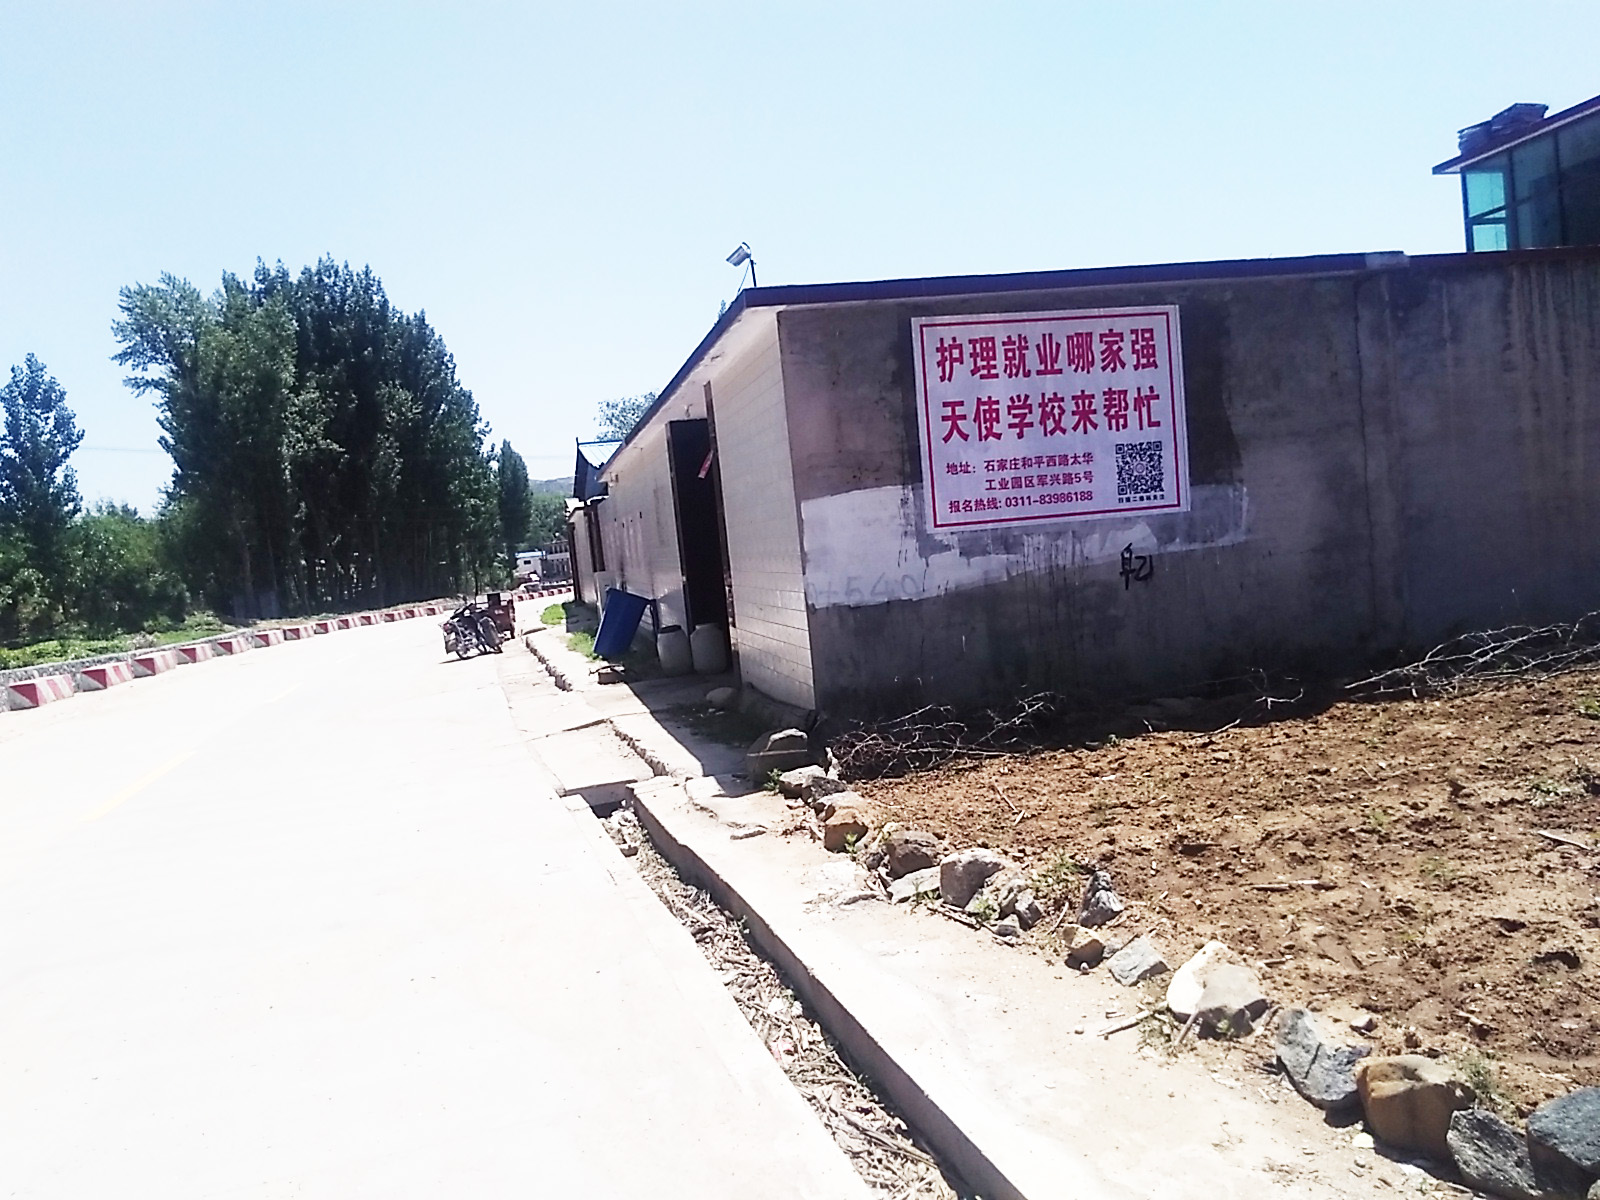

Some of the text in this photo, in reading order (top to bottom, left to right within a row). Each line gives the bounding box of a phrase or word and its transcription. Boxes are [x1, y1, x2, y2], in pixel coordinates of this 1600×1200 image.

[936, 328, 1158, 382] 护理就业哪家强
[941, 386, 1161, 444] 天使学校来帮忙
[985, 471, 1094, 491] 工业园区军兴路5号
